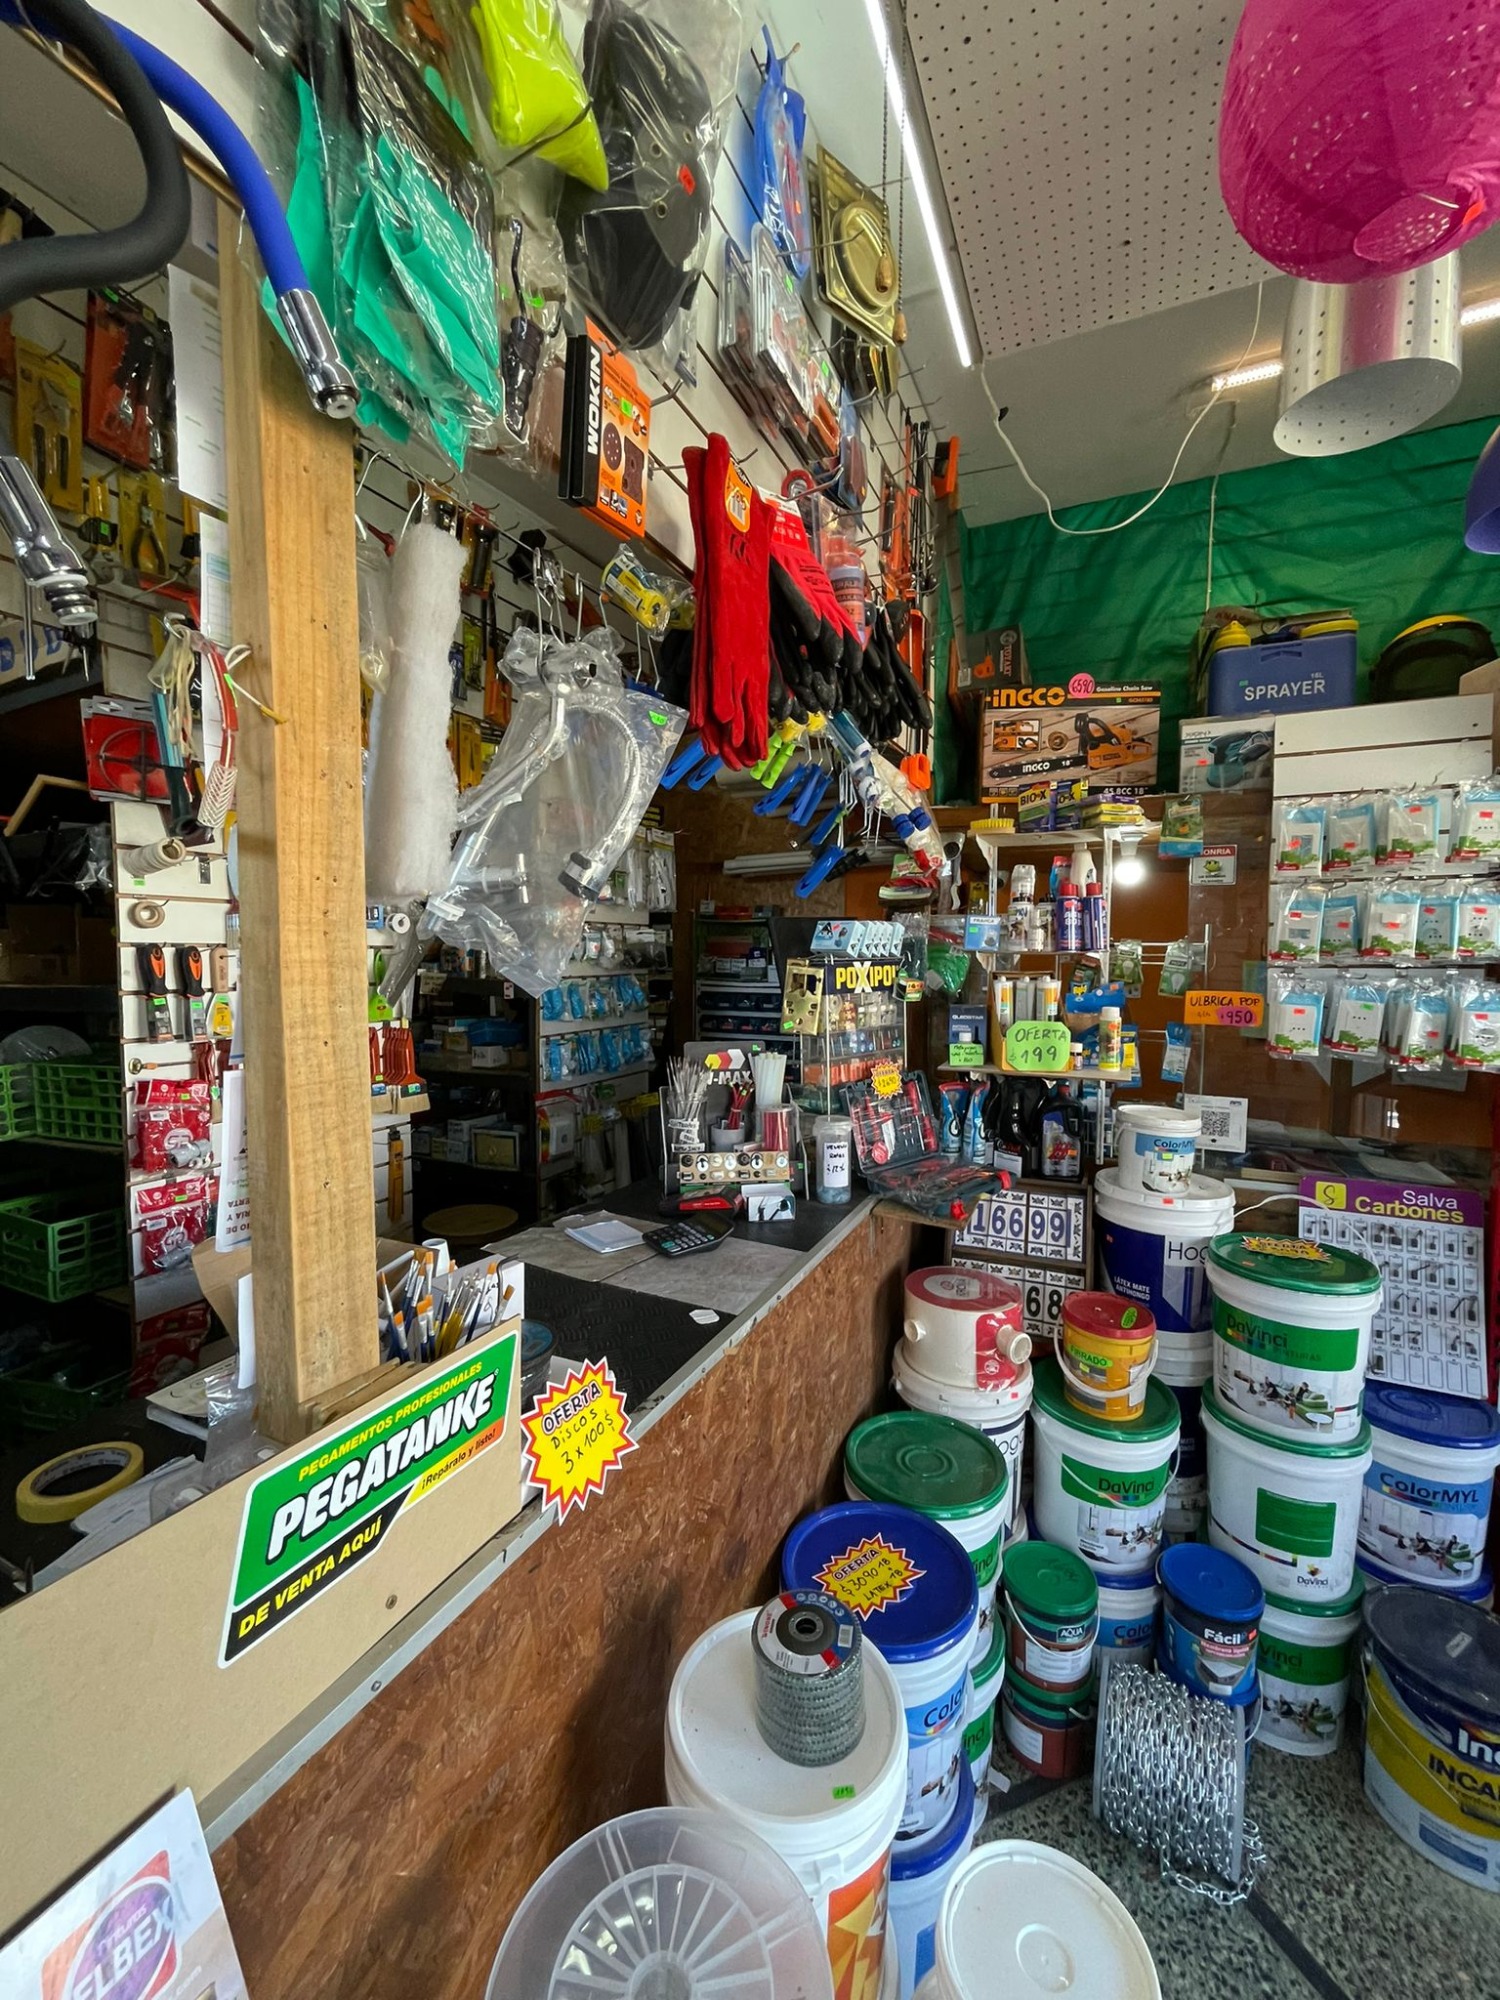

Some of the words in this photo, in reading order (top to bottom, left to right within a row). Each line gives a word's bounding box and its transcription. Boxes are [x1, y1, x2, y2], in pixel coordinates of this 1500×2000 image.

[587, 346, 601, 455] WOKIN
[993, 686, 1065, 707] INGCO
[1244, 680, 1326, 701] SPRAYER
[1022, 762, 1050, 773] INGCO
[1240, 997, 1260, 1006] POP
[1015, 1026, 1067, 1042] OFERTA
[1355, 1196, 1464, 1224] Carbones
[1402, 1190, 1458, 1210] Salva
[1168, 1240, 1209, 1265] Hog
[1132, 1282, 1150, 1294] MATE
[1226, 1313, 1288, 1349] DaVinci
[543, 1382, 601, 1433] OFERTA
[298, 1414, 394, 1482] PEGAMENTOS
[394, 1361, 482, 1423] PROFESIONALES
[267, 1373, 496, 1561] PEGATANKE
[421, 1451, 467, 1490] ¡Repáralo
[468, 1445, 475, 1458] y
[474, 1428, 496, 1452] listo!
[1098, 1476, 1155, 1494] DaVinci
[1380, 1472, 1480, 1504] ColorMYL
[834, 1549, 880, 1580] OFERTA
[238, 1608, 269, 1639] DE
[274, 1560, 336, 1612] VENTA
[338, 1515, 384, 1570] AQUÍ
[1297, 1575, 1329, 1586] DaVinci
[863, 1580, 892, 1601] LATEX
[1060, 1626, 1083, 1637] AQUA
[1114, 1624, 1152, 1639] Colo
[1204, 1628, 1241, 1645] Fácil
[1259, 1642, 1303, 1667] Vinci
[1428, 1753, 1500, 1801] INCA
